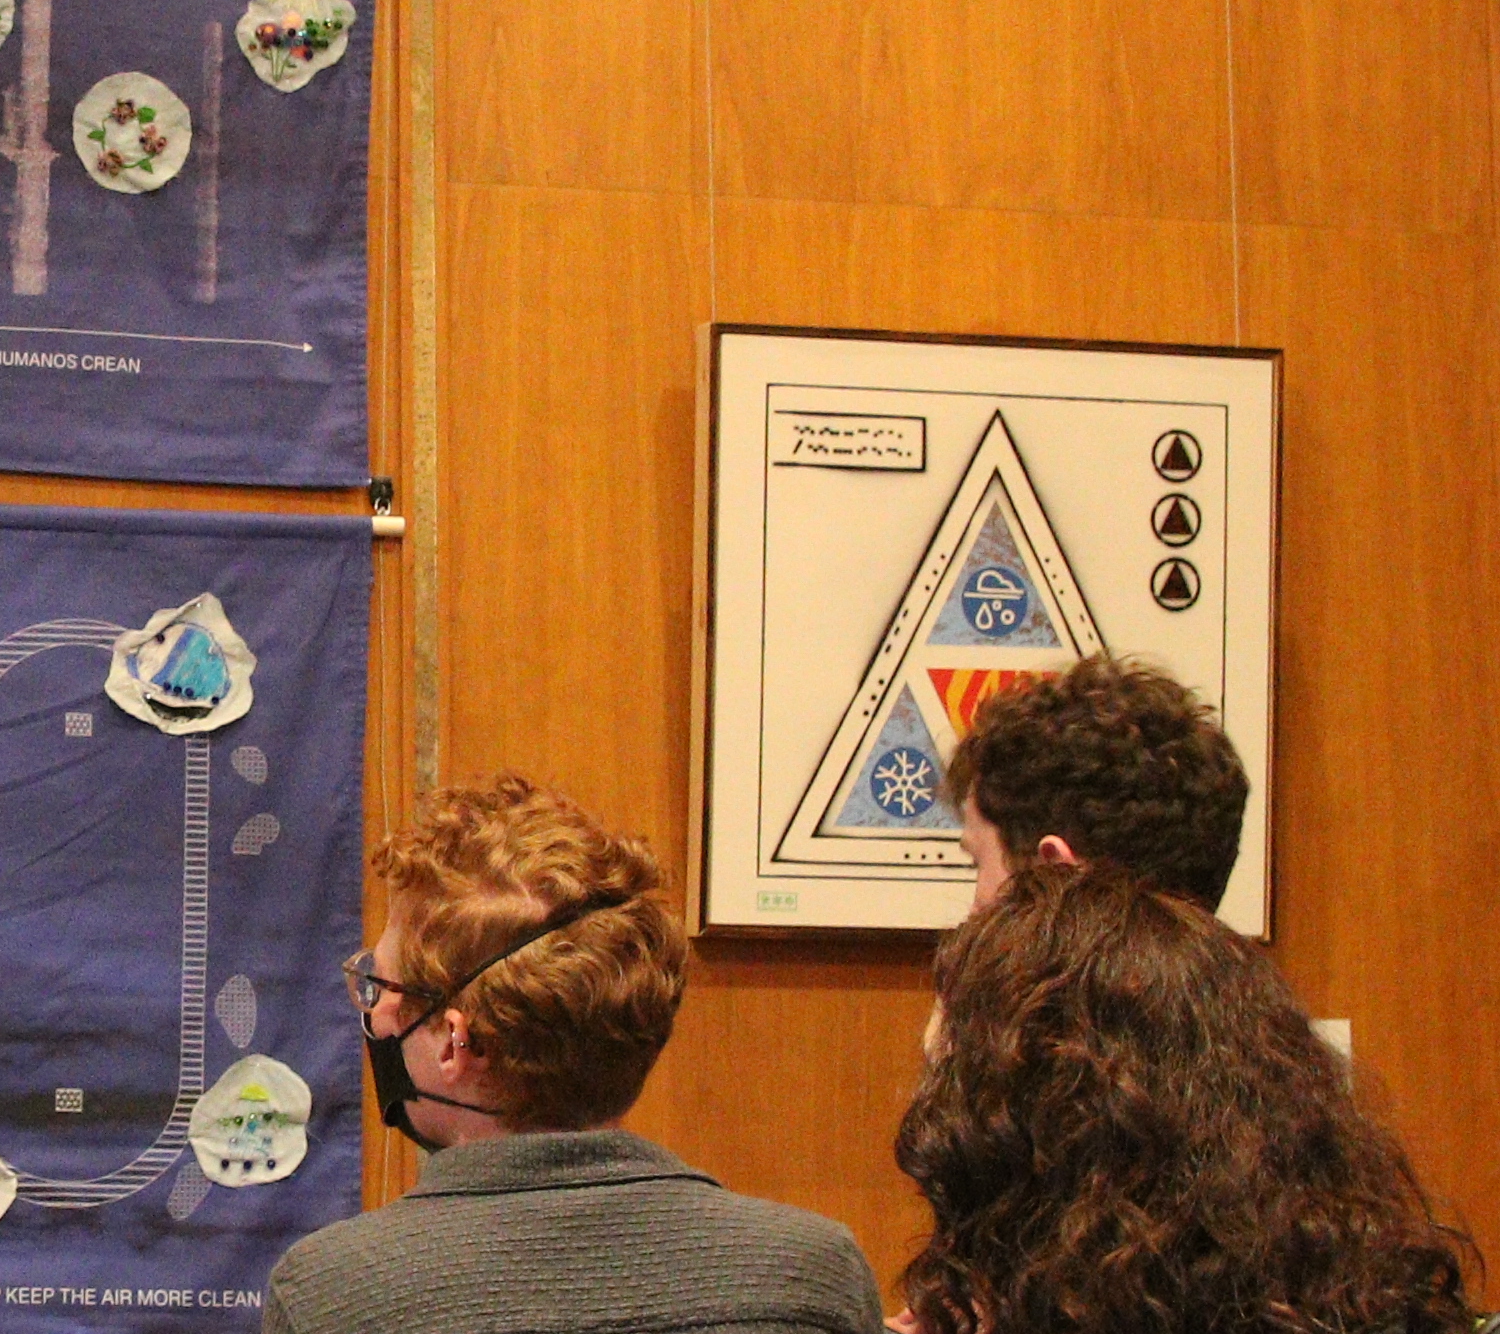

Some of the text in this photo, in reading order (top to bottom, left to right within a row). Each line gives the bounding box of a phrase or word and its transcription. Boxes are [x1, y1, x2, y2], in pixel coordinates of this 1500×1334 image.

[81, 355, 141, 374] CREAN
[5, 1287, 54, 1305] KEEP
[59, 1287, 97, 1305] THE
[100, 1288, 133, 1306] AIR
[137, 1289, 194, 1307] MORE
[198, 1289, 262, 1308] CLEAN
